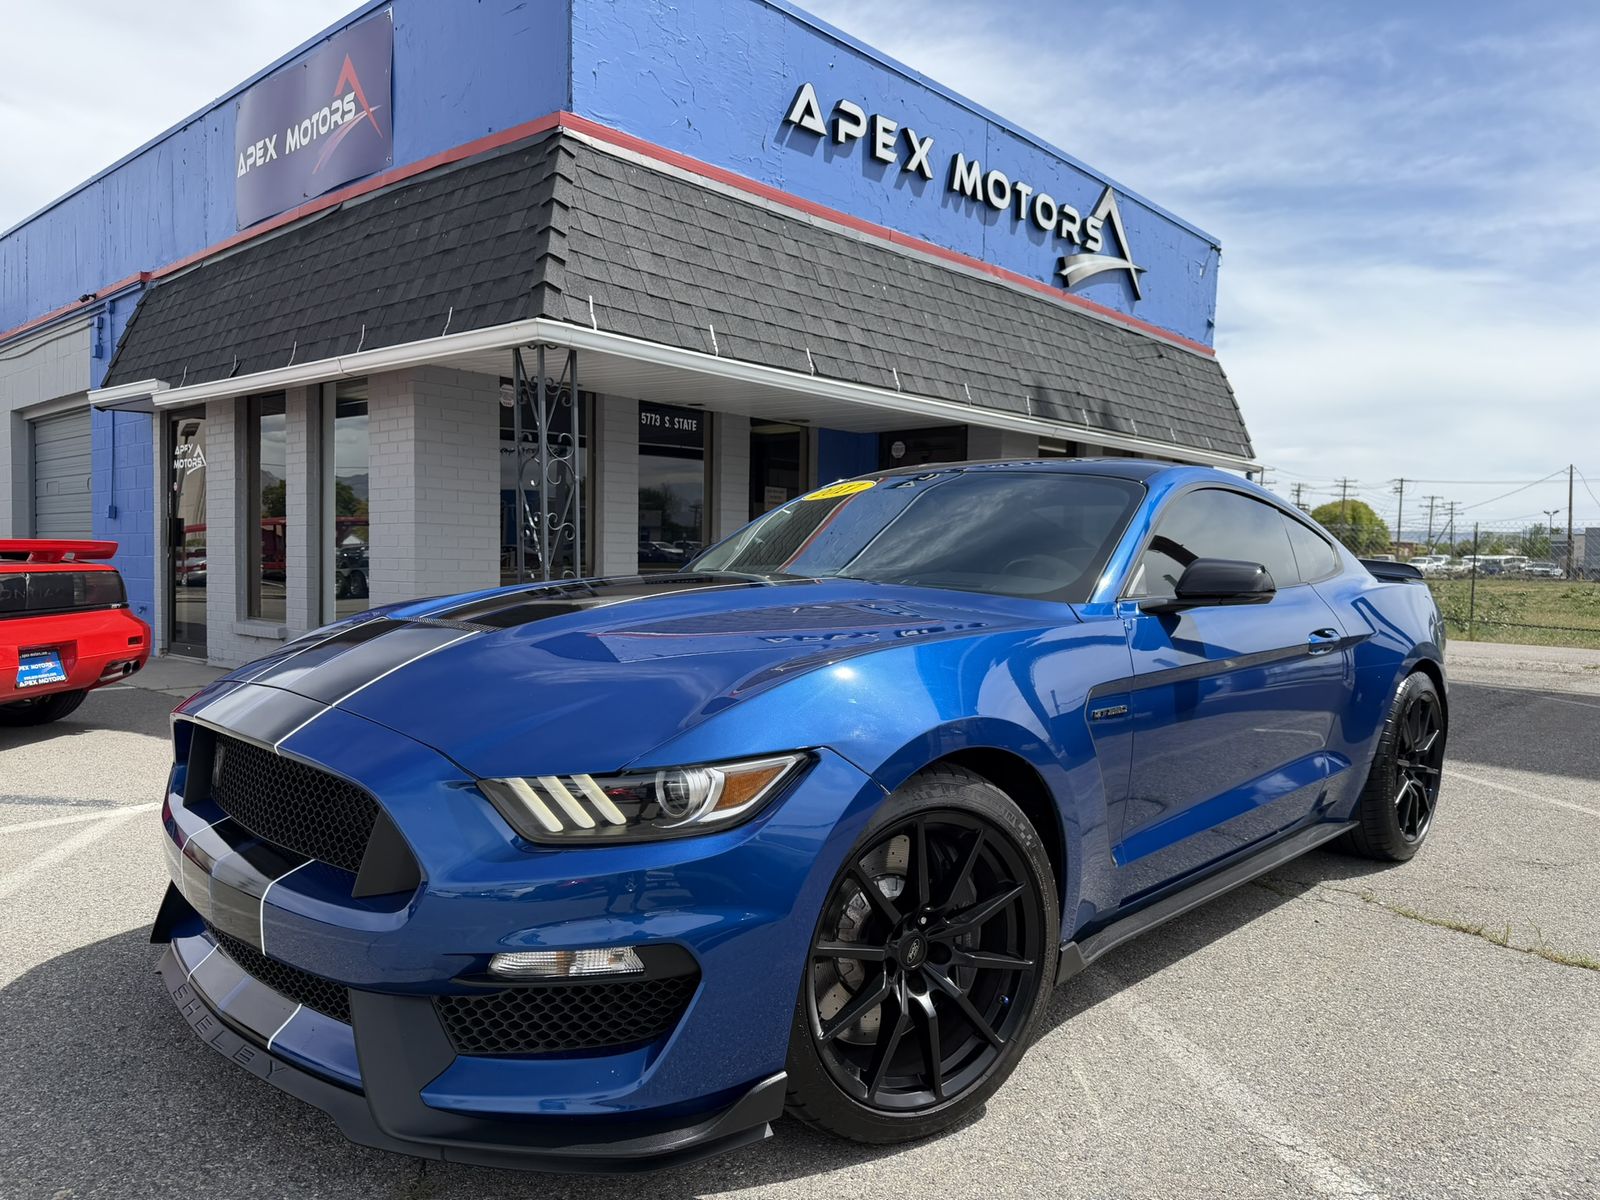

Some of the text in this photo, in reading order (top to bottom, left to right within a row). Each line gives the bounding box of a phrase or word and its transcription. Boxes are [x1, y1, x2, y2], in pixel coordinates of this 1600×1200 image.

[237, 92, 356, 179] APEX MOTORS
[784, 82, 1103, 252] APEX MOTORS
[641, 412, 697, 431] 5773 S. STATE
[173, 458, 203, 470] MOTORS
[19, 679, 38, 687] APEX
[172, 983, 288, 1079] SHELBY
